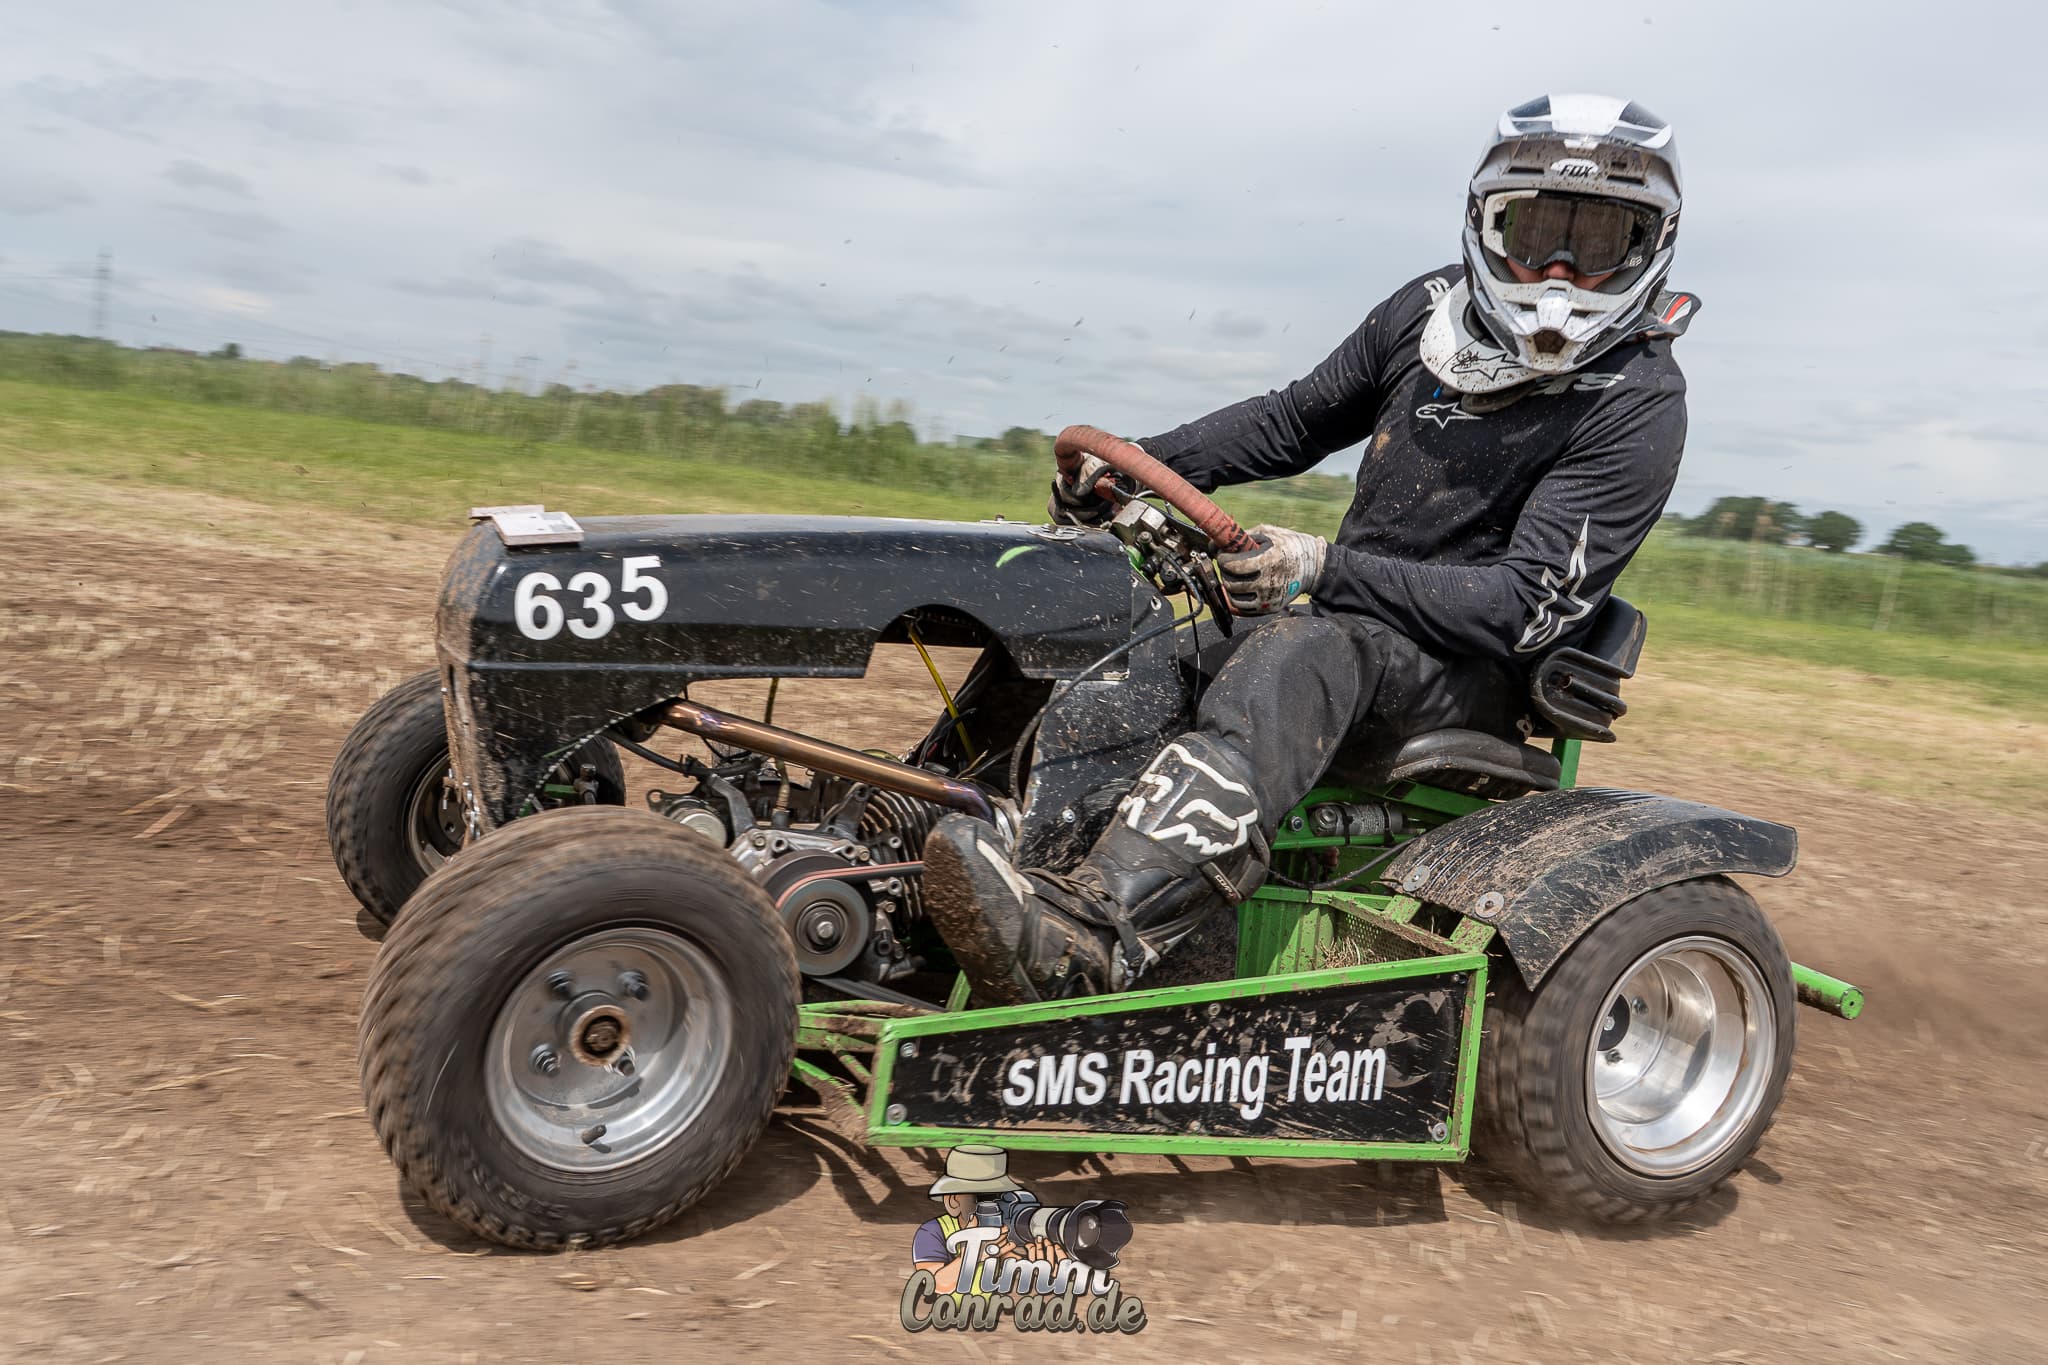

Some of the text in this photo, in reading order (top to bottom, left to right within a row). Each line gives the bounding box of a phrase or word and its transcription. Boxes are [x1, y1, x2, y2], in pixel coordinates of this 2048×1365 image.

[1559, 164, 1593, 178] FOX
[514, 555, 669, 640] 635
[1003, 1036, 1387, 1121] SMS Racing Team
